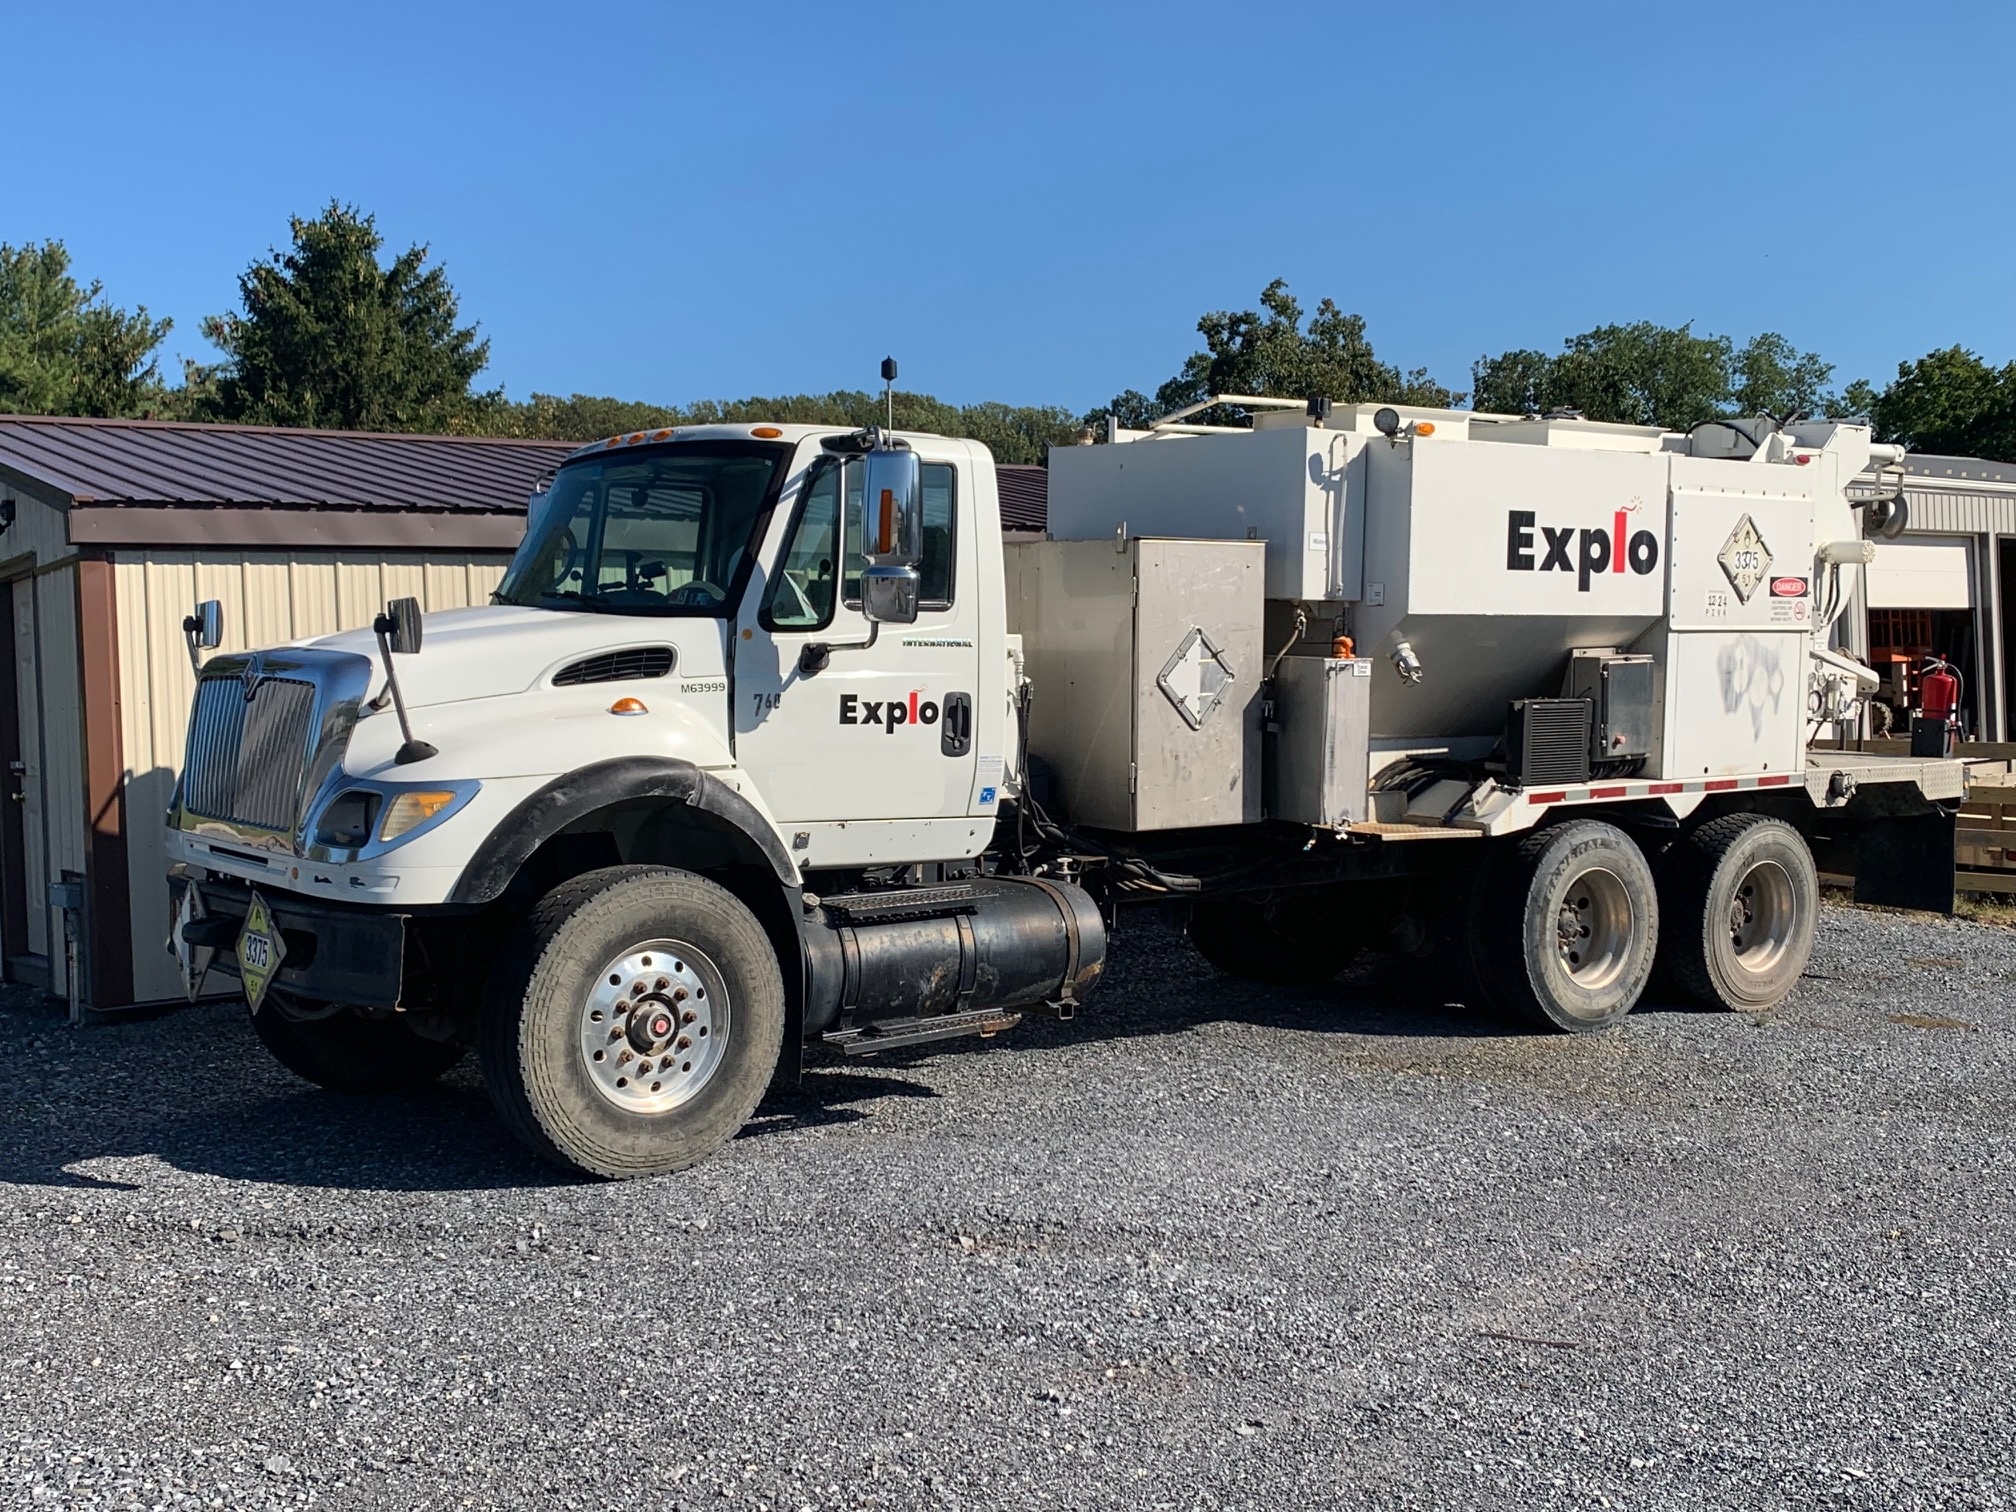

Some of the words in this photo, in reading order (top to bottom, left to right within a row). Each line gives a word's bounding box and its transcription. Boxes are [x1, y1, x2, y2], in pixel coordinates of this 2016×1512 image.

[1507, 510, 1659, 593] Explo
[1735, 551, 1759, 570] 3375
[1775, 581, 1802, 592] DANGER
[902, 637, 973, 648] INTERNATIONAL
[680, 682, 726, 694] M63999
[838, 692, 939, 734] Explo
[246, 935, 268, 968] 3375
